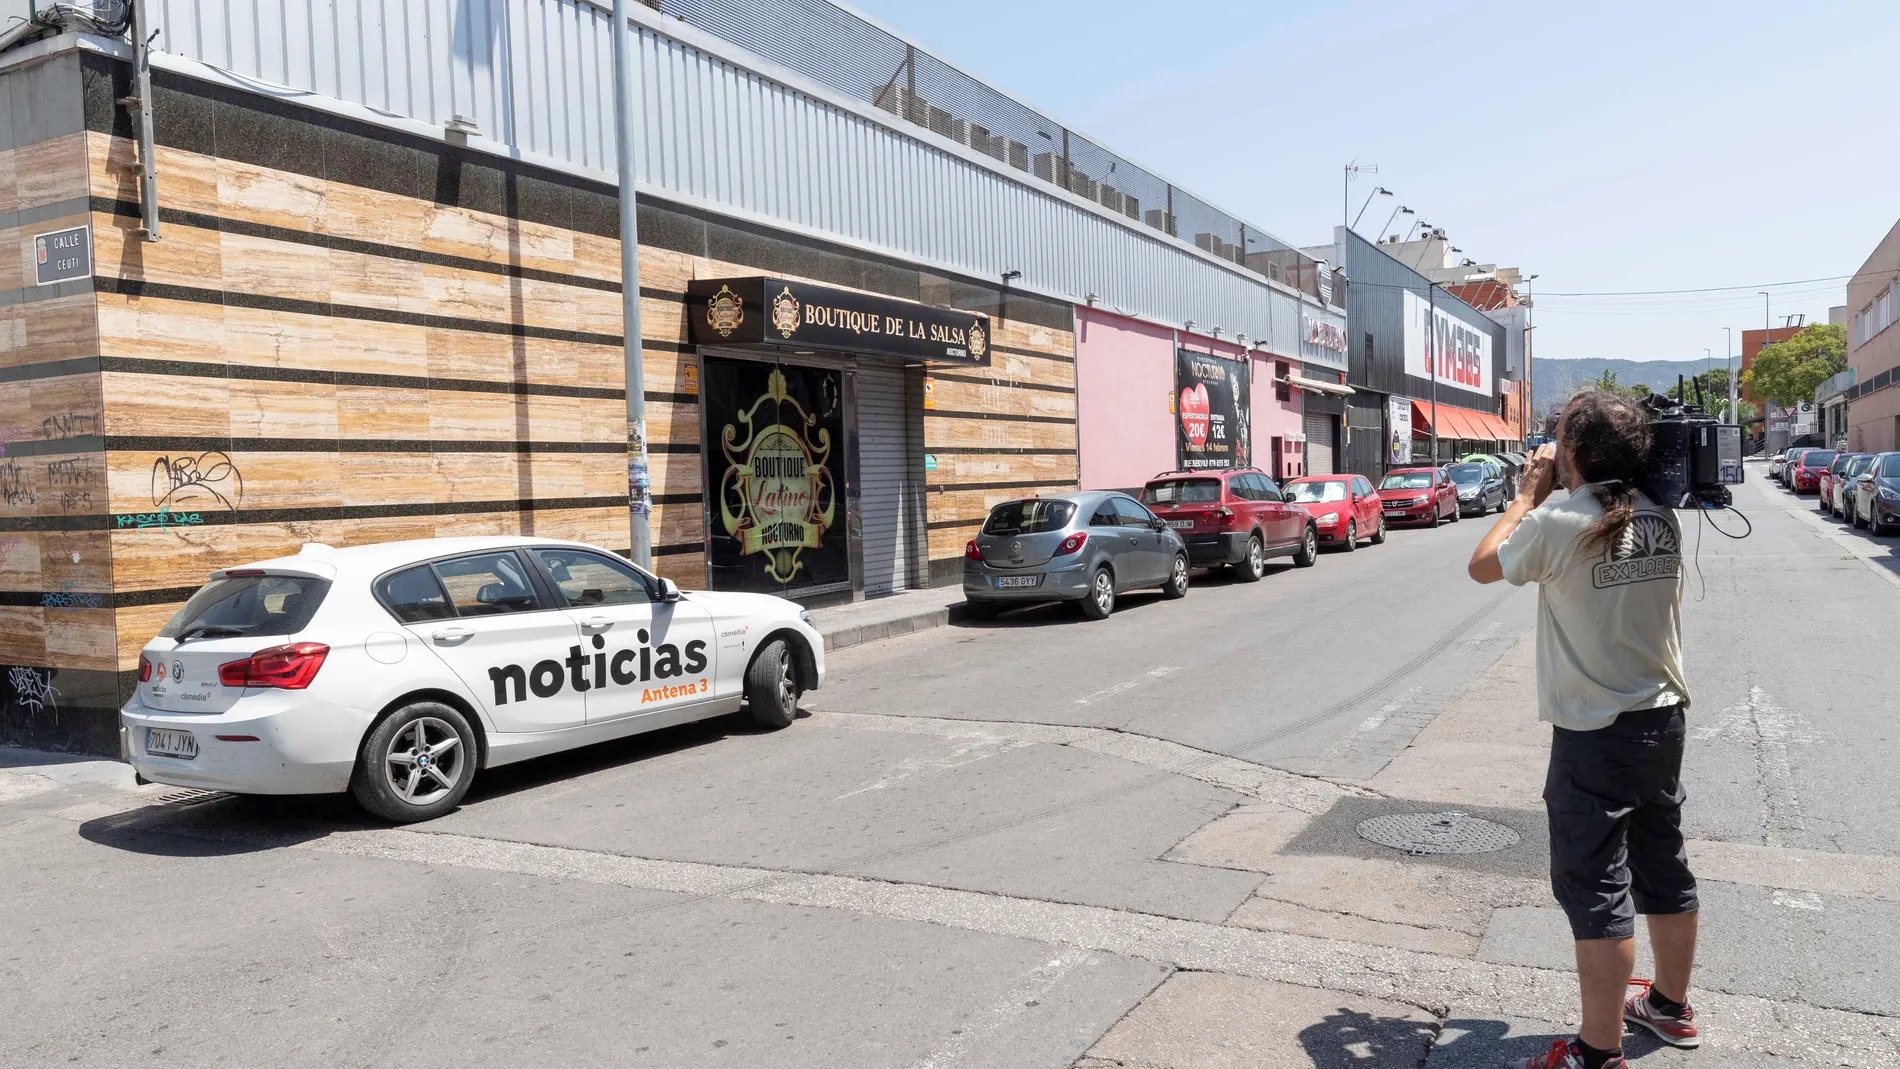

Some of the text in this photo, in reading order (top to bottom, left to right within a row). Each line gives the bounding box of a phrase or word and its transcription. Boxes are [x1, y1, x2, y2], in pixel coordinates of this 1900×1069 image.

[54, 234, 79, 249] CALLE
[57, 258, 79, 270] CEUTI
[805, 304, 880, 334] BOUTIQUE
[885, 316, 904, 336] DE
[909, 320, 926, 339] LA
[930, 323, 966, 345] SALSA
[1189, 422, 1205, 438] 20€
[1212, 424, 1226, 439] 12€
[755, 456, 805, 478] BOUTIQUE
[753, 479, 811, 516] Latino
[762, 522, 805, 545] NOCTURNO
[1000, 576, 1037, 586] 5436 GYY
[487, 628, 708, 706] noticias
[180, 692, 207, 701] cbmedia
[641, 678, 708, 704] Antena 3
[150, 731, 195, 753] 7041 JYN
